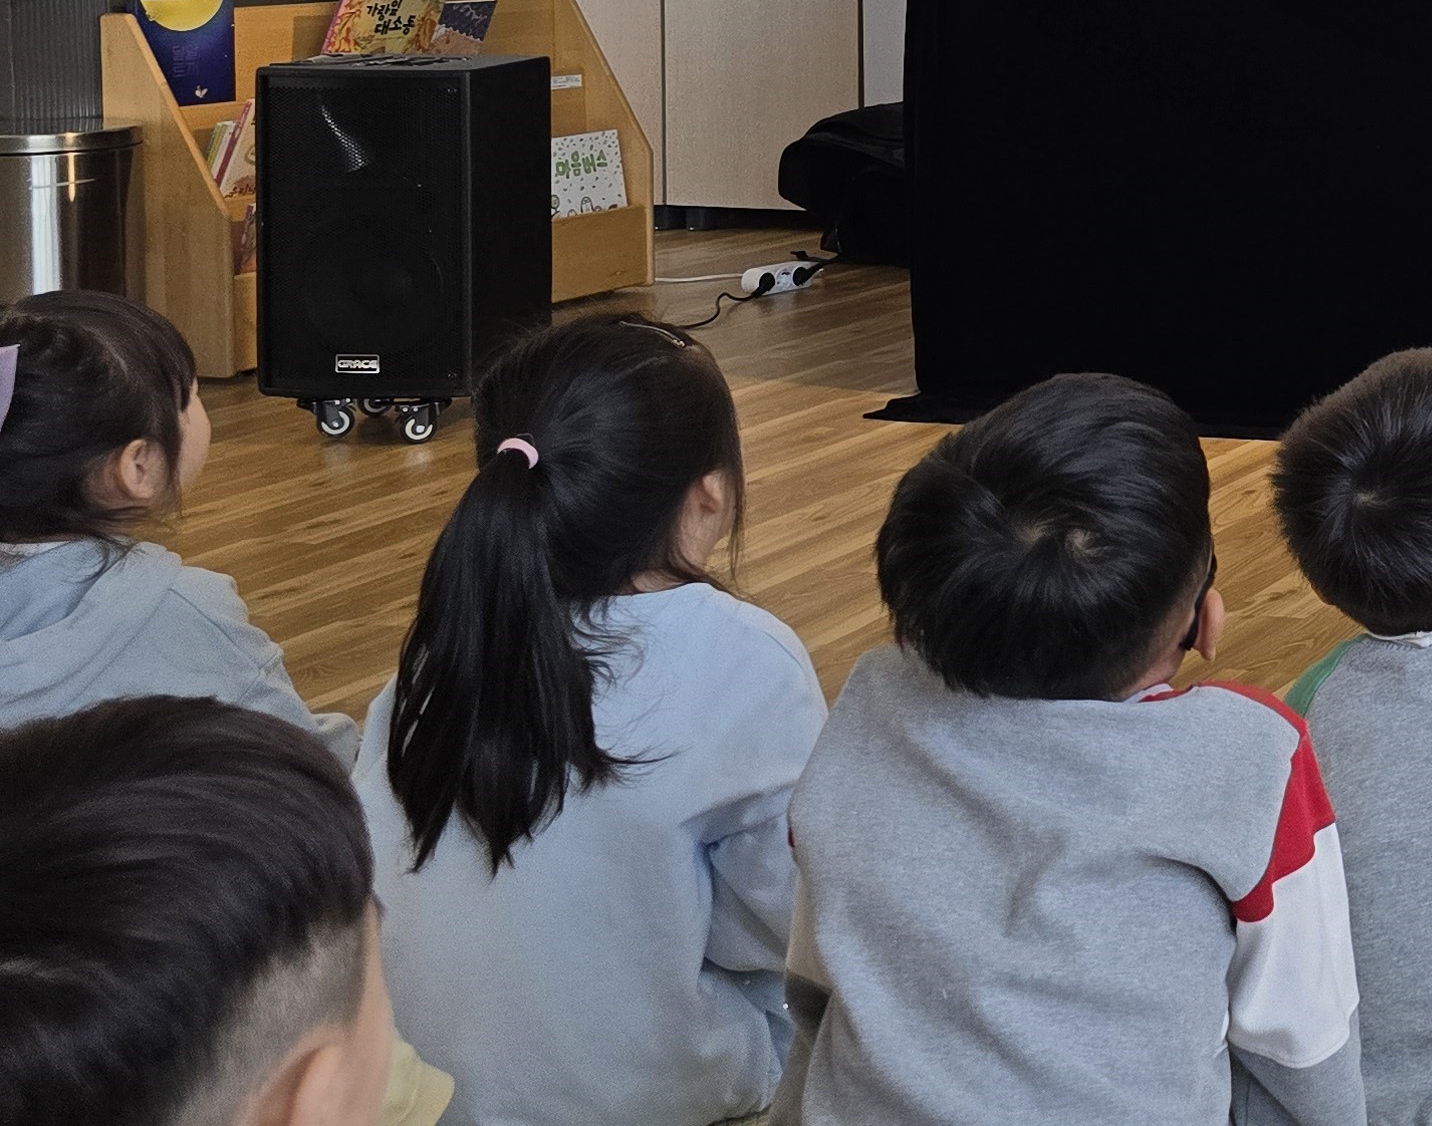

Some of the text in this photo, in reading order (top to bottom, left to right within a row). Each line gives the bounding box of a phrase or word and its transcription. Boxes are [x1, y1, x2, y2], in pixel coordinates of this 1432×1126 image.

[366, 0, 403, 21] 가랑잎
[374, 15, 416, 35] 대소동
[556, 150, 608, 179] 마음버스
